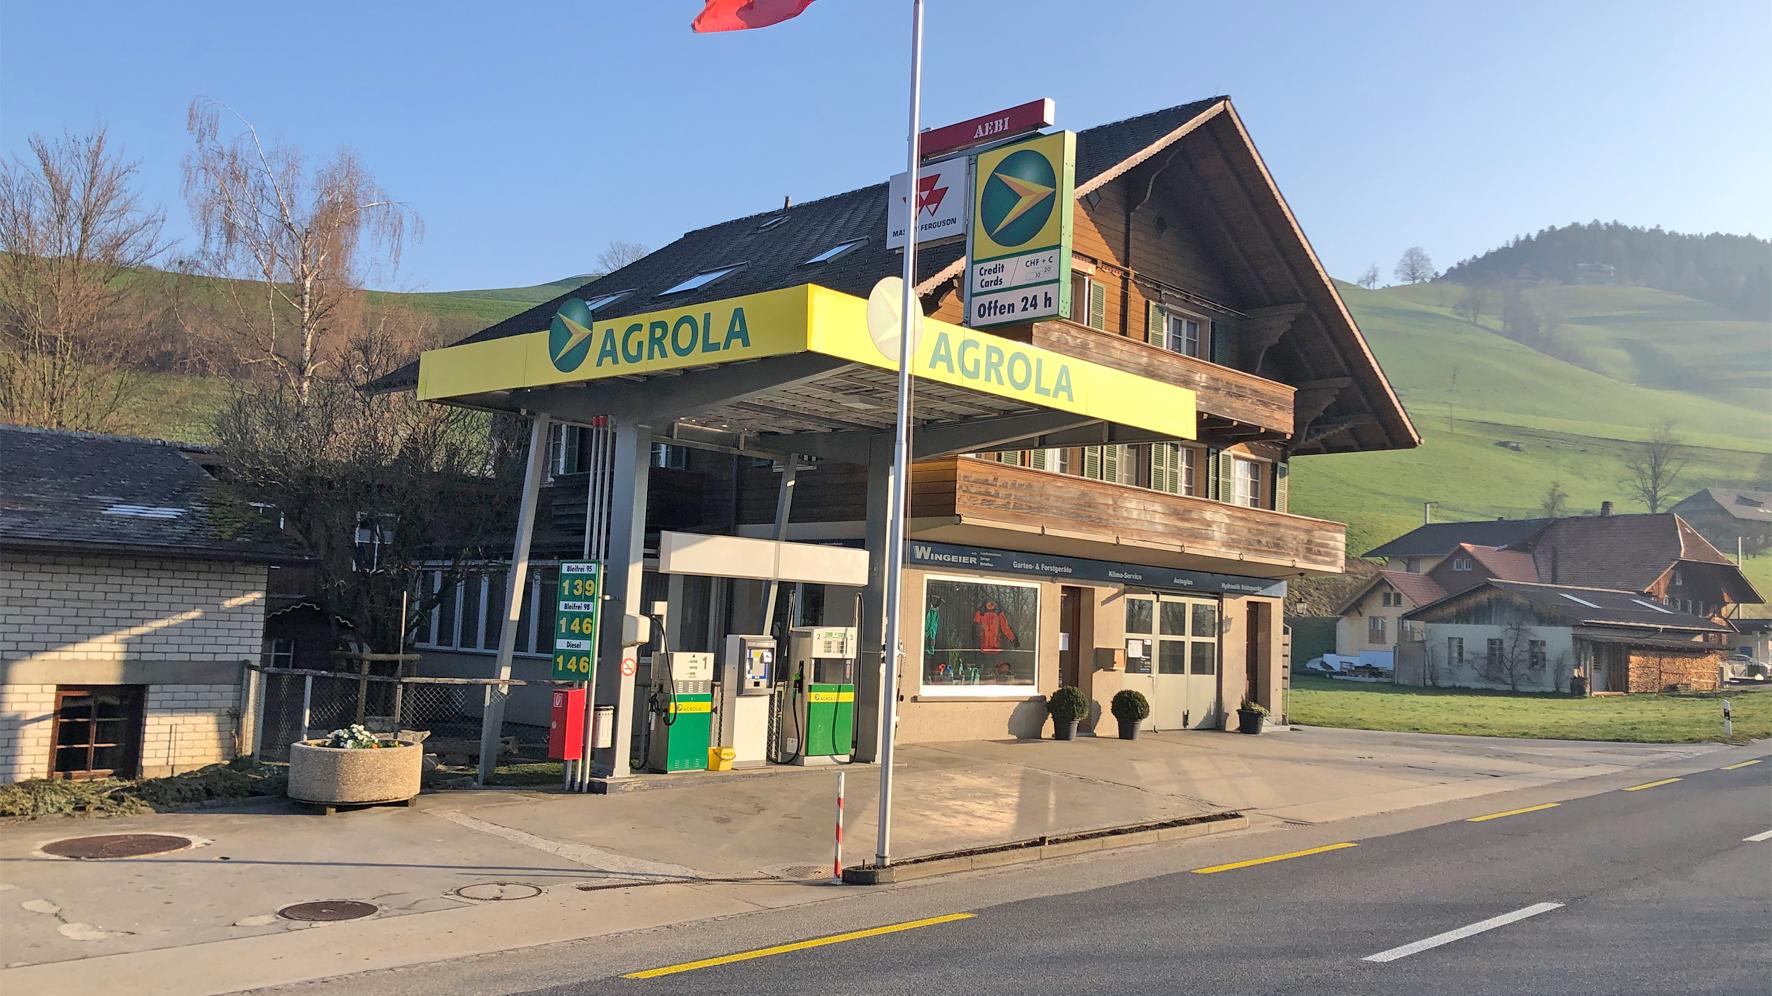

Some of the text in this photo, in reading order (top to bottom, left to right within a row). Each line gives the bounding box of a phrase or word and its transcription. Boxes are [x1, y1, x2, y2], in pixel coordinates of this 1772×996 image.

[973, 117, 1010, 139] AEBI
[920, 217, 957, 232] FERGUSON
[979, 263, 1005, 277] Credit
[1025, 258, 1039, 268] CHF
[980, 276, 1003, 289] Cards
[977, 291, 1052, 319] Offen 24 h
[596, 307, 751, 368] AGROLA
[928, 331, 1074, 402] AGROLA
[913, 545, 977, 565] WINGEIER
[566, 563, 593, 573] Bleifrei 95
[1012, 560, 1073, 574] Garten- & Forstgeräte
[564, 602, 590, 611] Bleifrei 98
[566, 640, 582, 649] Diesel
